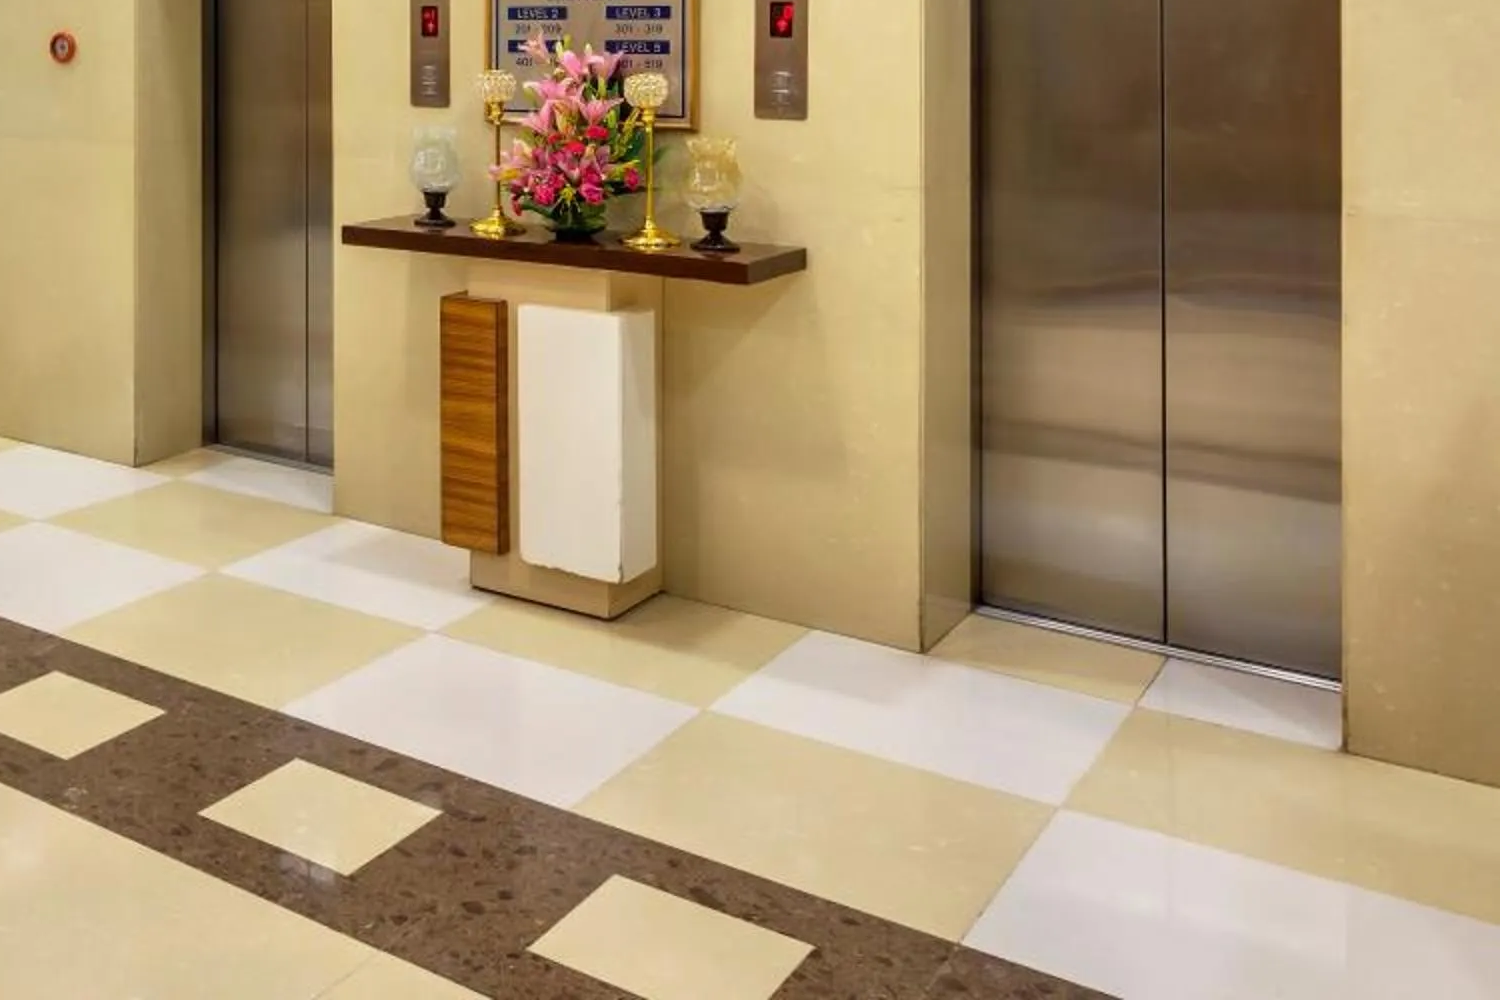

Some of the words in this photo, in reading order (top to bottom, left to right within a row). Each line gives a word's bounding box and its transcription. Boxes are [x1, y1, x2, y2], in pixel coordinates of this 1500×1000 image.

[517, 7, 549, 19] LEVEL
[615, 7, 650, 18] LEVEL
[615, 42, 651, 53] LEVEL
